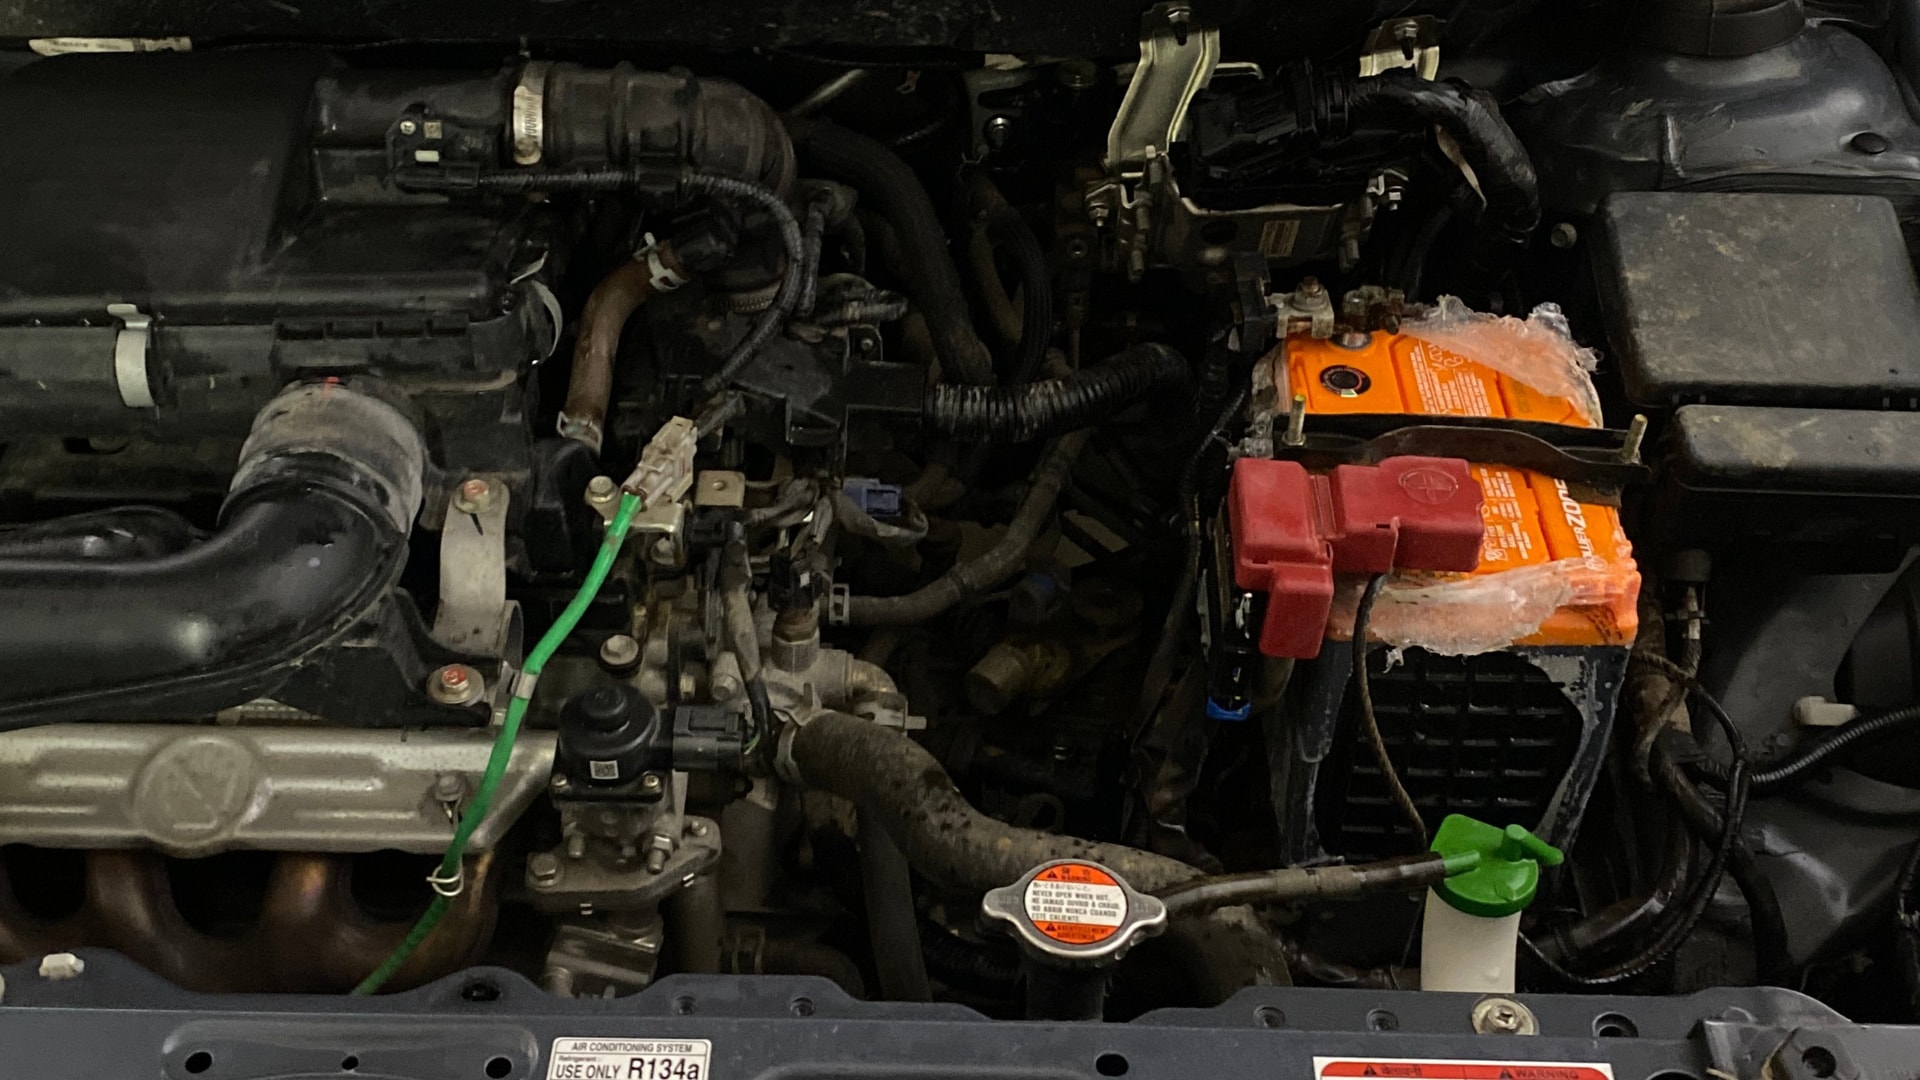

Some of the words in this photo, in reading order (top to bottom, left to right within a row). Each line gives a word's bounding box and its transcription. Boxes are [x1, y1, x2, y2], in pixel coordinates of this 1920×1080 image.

[1090, 909, 1117, 917] CUANDO
[571, 1042, 587, 1050] AIR
[589, 1043, 653, 1052] CONDITIONING
[656, 1044, 692, 1053] SYSTEM
[556, 1064, 582, 1079] USE
[585, 1065, 621, 1079] ONLY
[627, 1058, 700, 1080] R134a
[1515, 1069, 1578, 1080] WARNING
